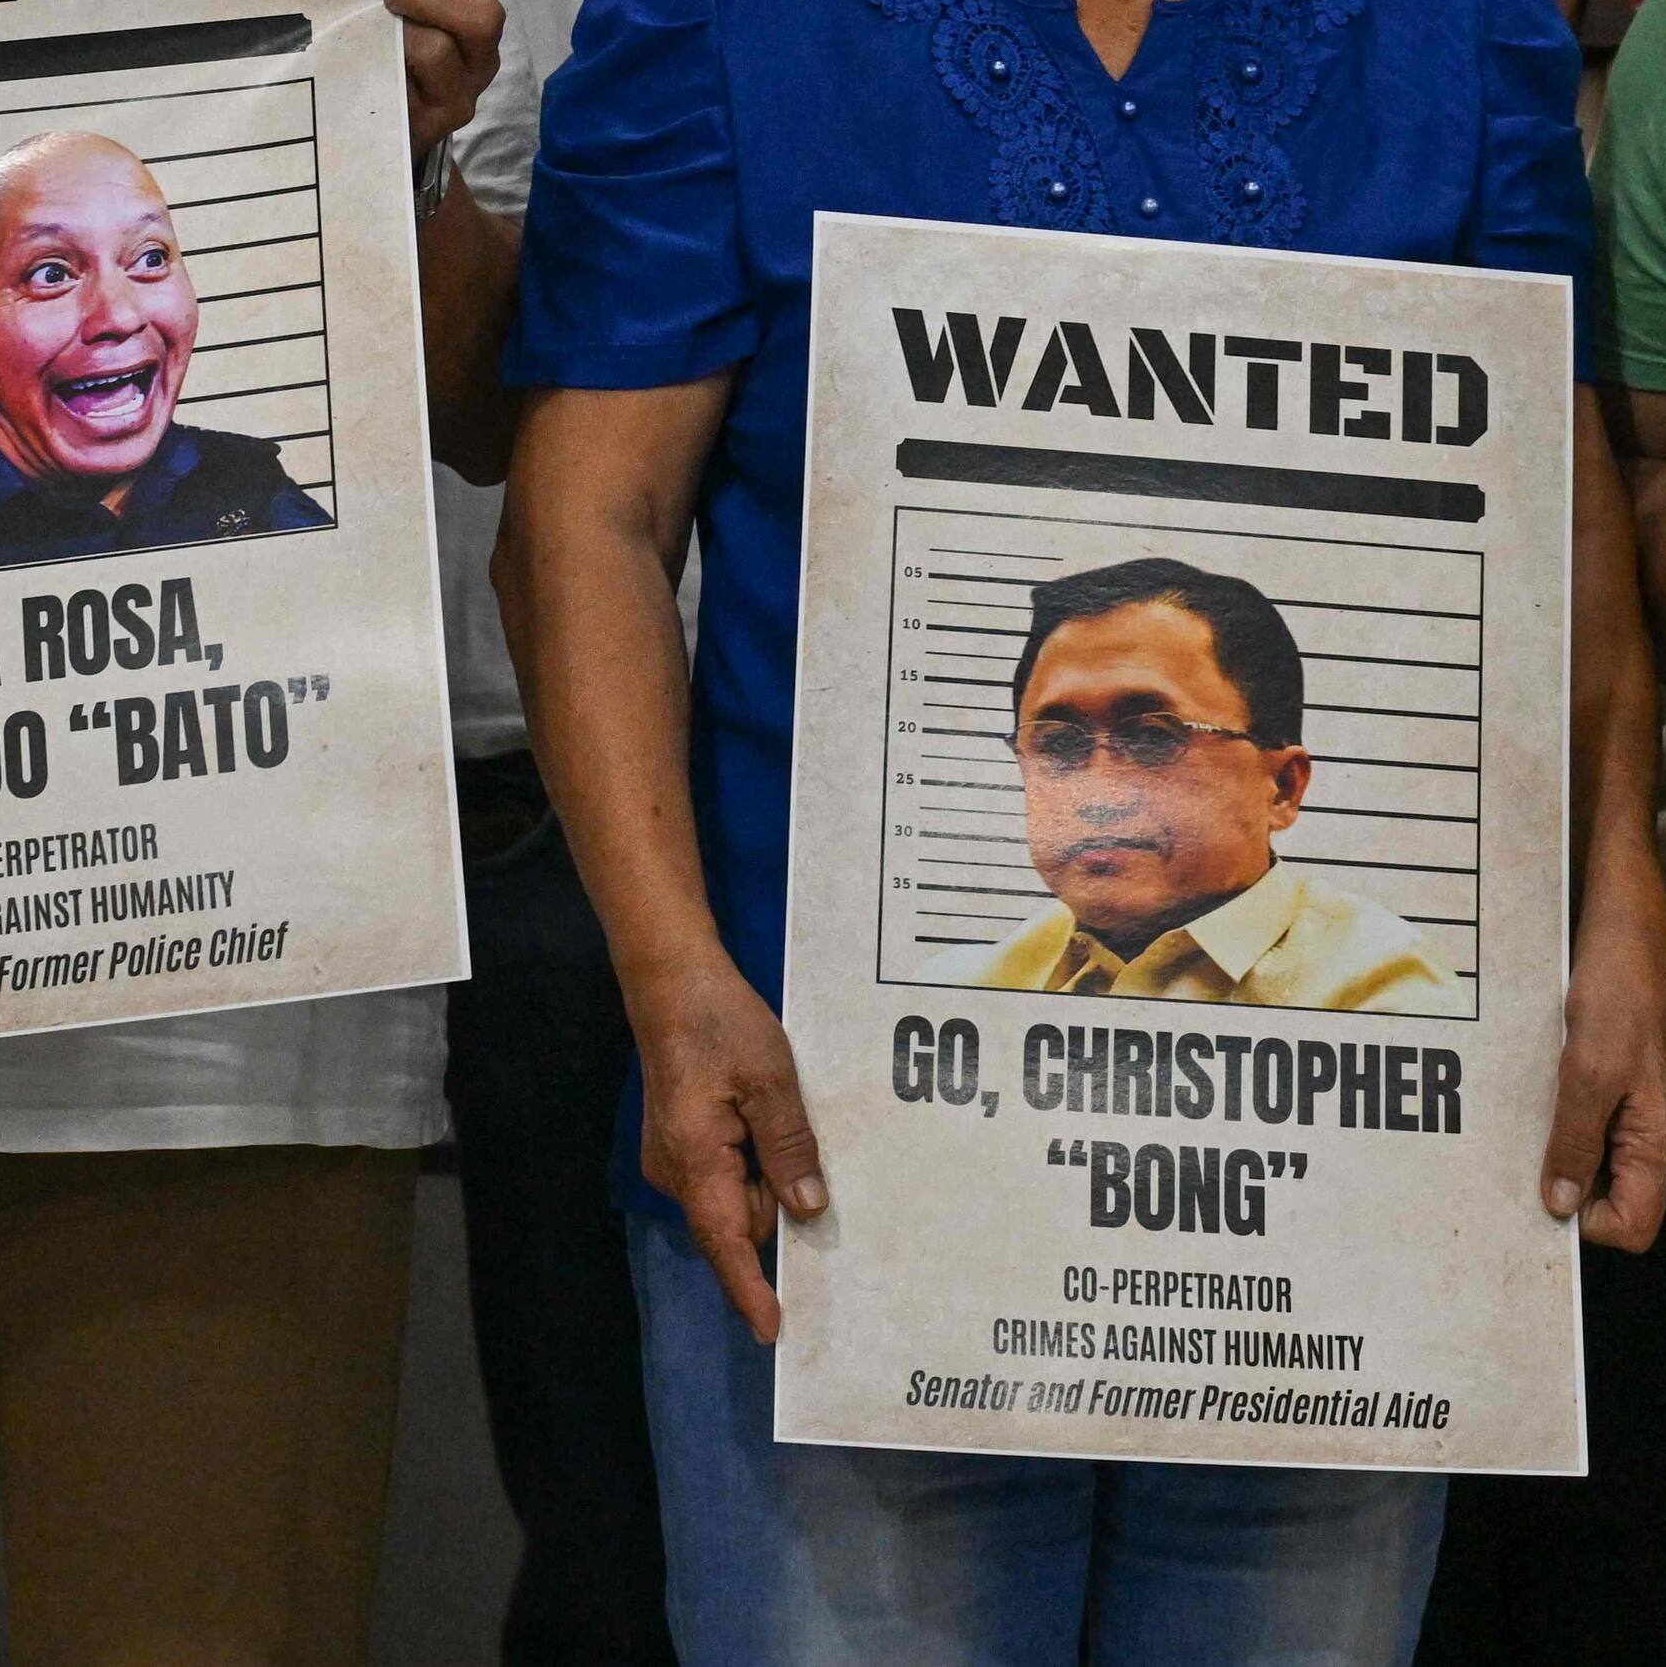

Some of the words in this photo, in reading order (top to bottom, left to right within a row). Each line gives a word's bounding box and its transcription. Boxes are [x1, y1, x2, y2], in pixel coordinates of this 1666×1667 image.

[892, 308, 1488, 447] WANTED
[904, 567, 923, 579] 05
[22, 577, 223, 682] ROSA,
[902, 618, 921, 630] 10
[900, 670, 918, 682] 15
[898, 721, 916, 733] 20
[896, 773, 914, 785] 25
[894, 825, 913, 837] 30
[91, 870, 234, 923] HUMANITY
[893, 877, 911, 890] 35
[109, 935, 201, 979] Police
[209, 921, 289, 967] Chief
[893, 1015, 999, 1118] GO,
[1023, 1024, 1461, 1134] CHRISTOPHER
[1064, 1266, 1291, 1313] CO-PERPETRATOR
[994, 1318, 1095, 1359] CRIMES
[1104, 1325, 1216, 1364] AGAINST
[1225, 1330, 1363, 1371] HUMANITY
[906, 1370, 1023, 1410] Senator
[1028, 1379, 1085, 1414] and
[1089, 1380, 1196, 1419] Former
[1199, 1385, 1380, 1427] Presidential
[1383, 1392, 1450, 1429] Aide
